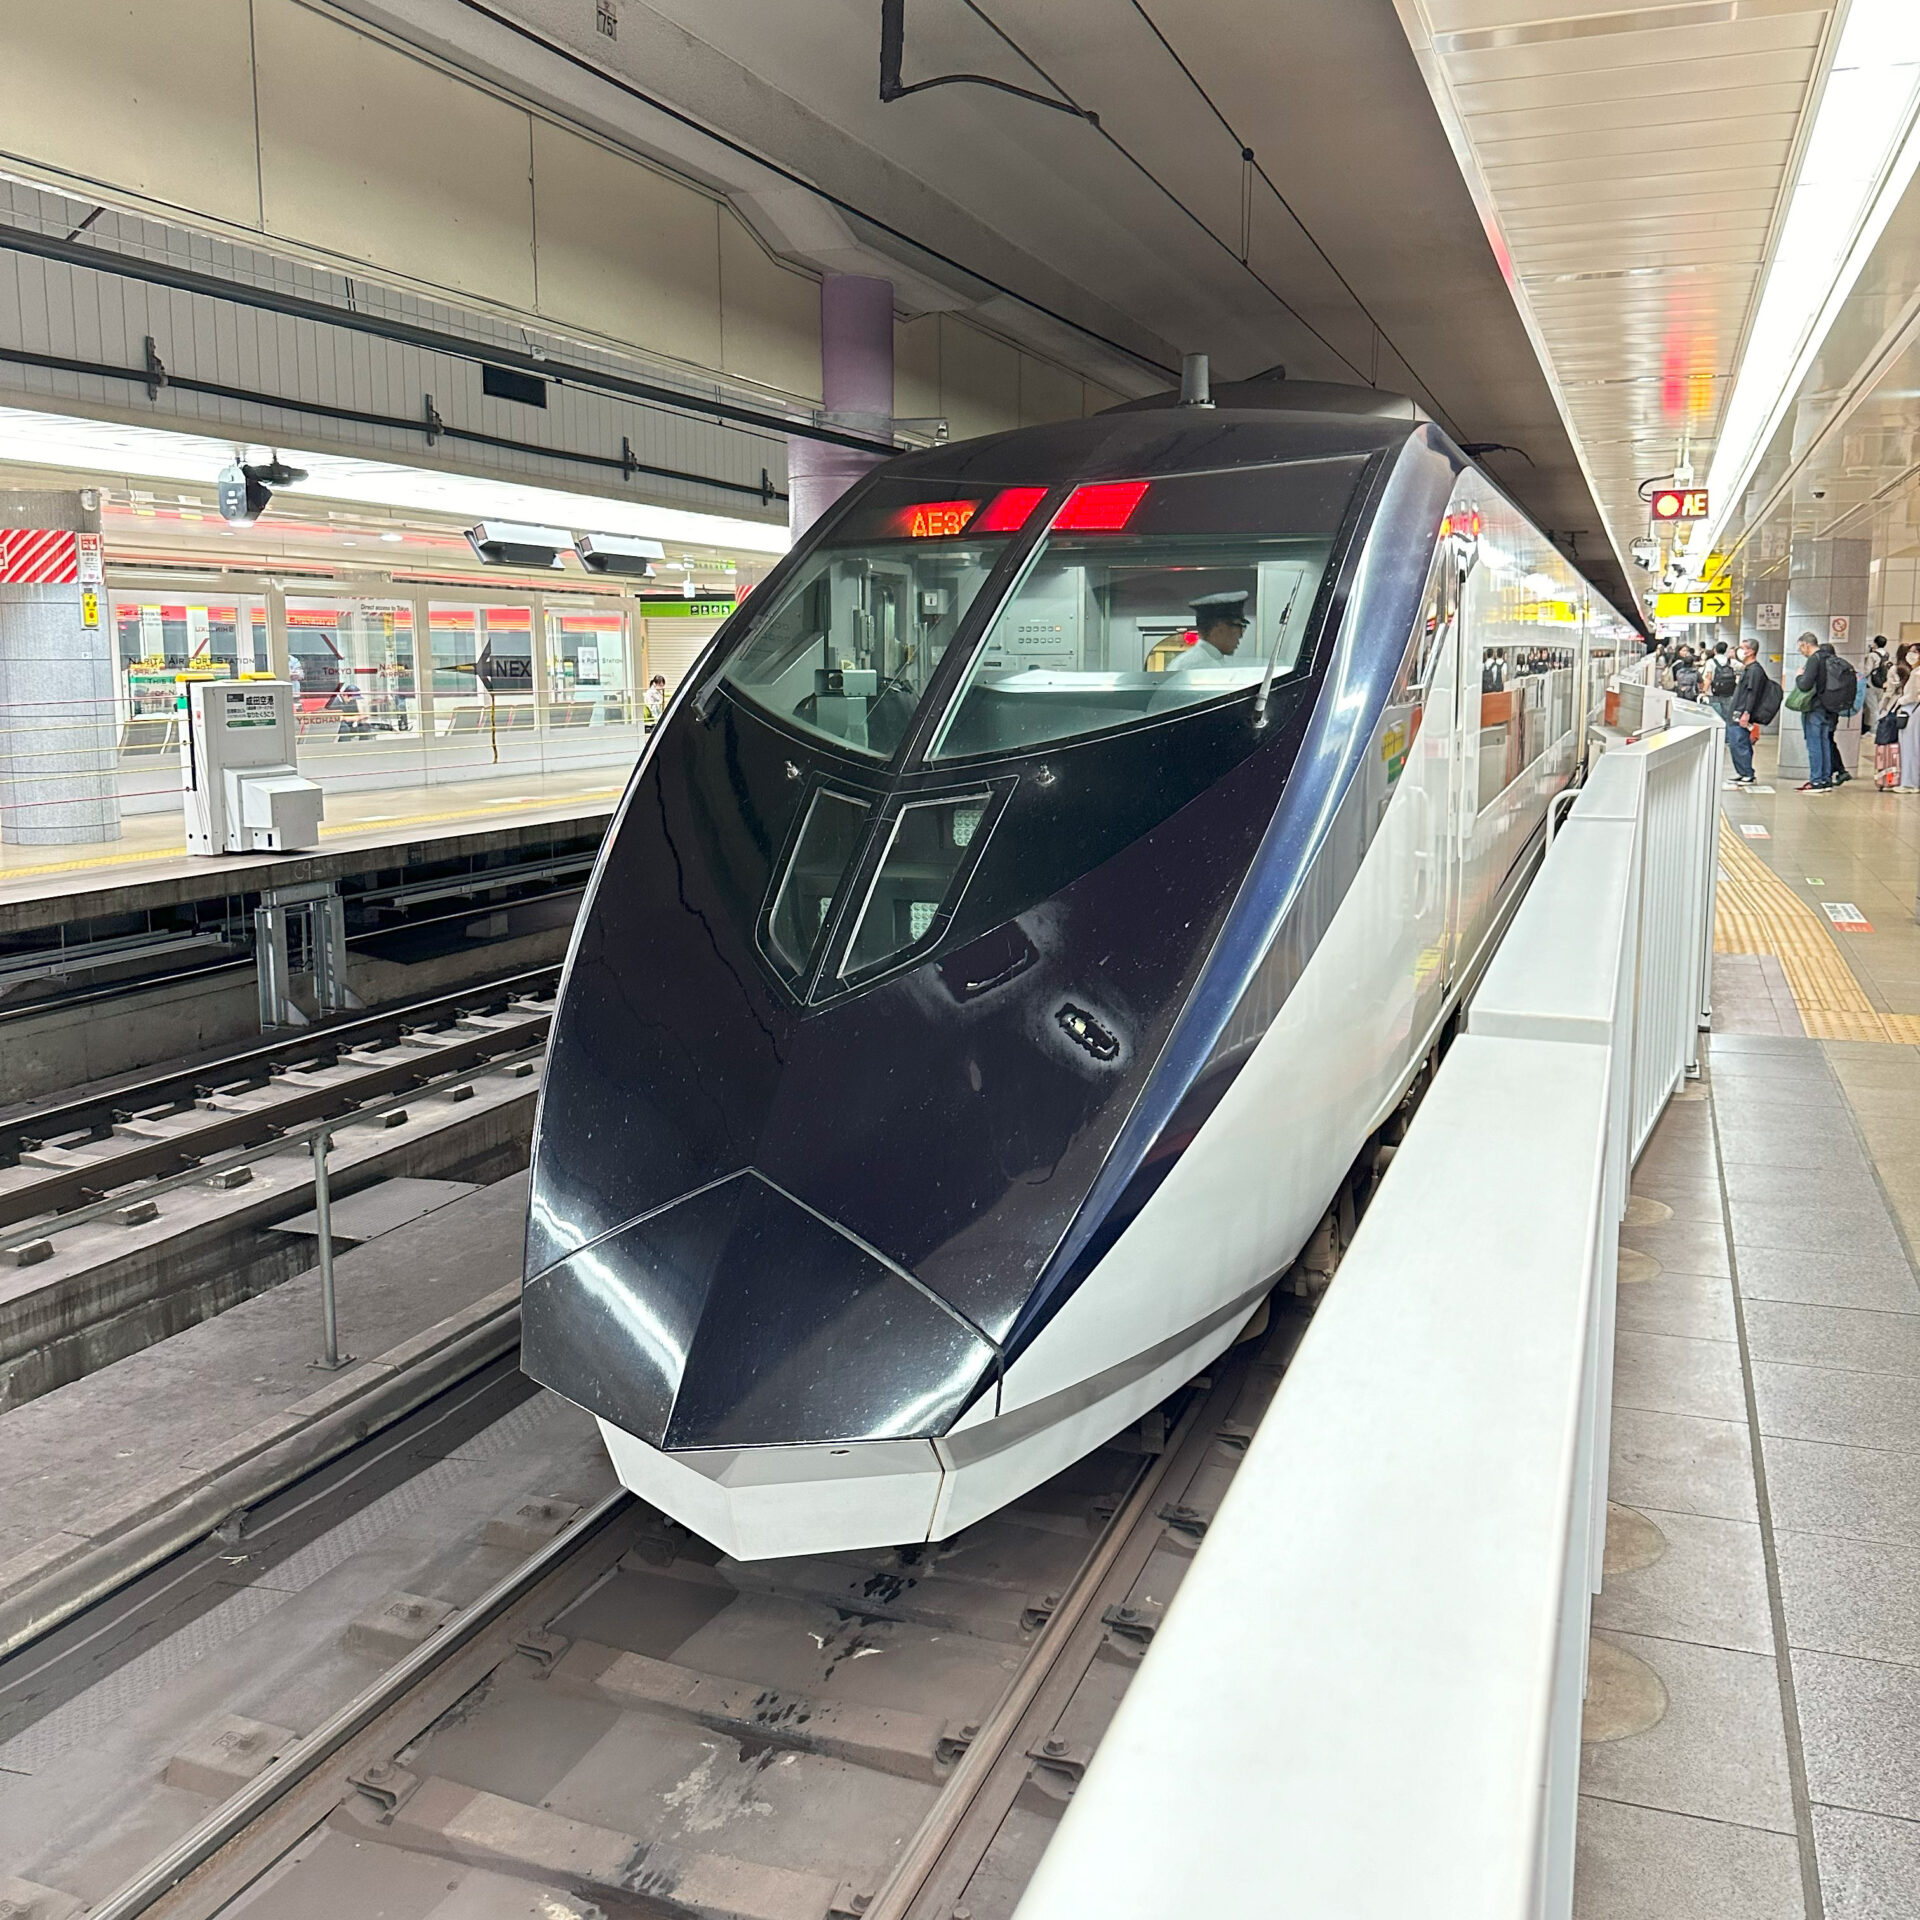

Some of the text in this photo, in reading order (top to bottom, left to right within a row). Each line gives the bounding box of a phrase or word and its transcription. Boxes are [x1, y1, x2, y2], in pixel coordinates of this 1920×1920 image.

[1681, 494, 1707, 516] AE
[168, 656, 185, 665] AIR
[216, 656, 255, 665] STATION
[322, 667, 352, 675] TOKYO
